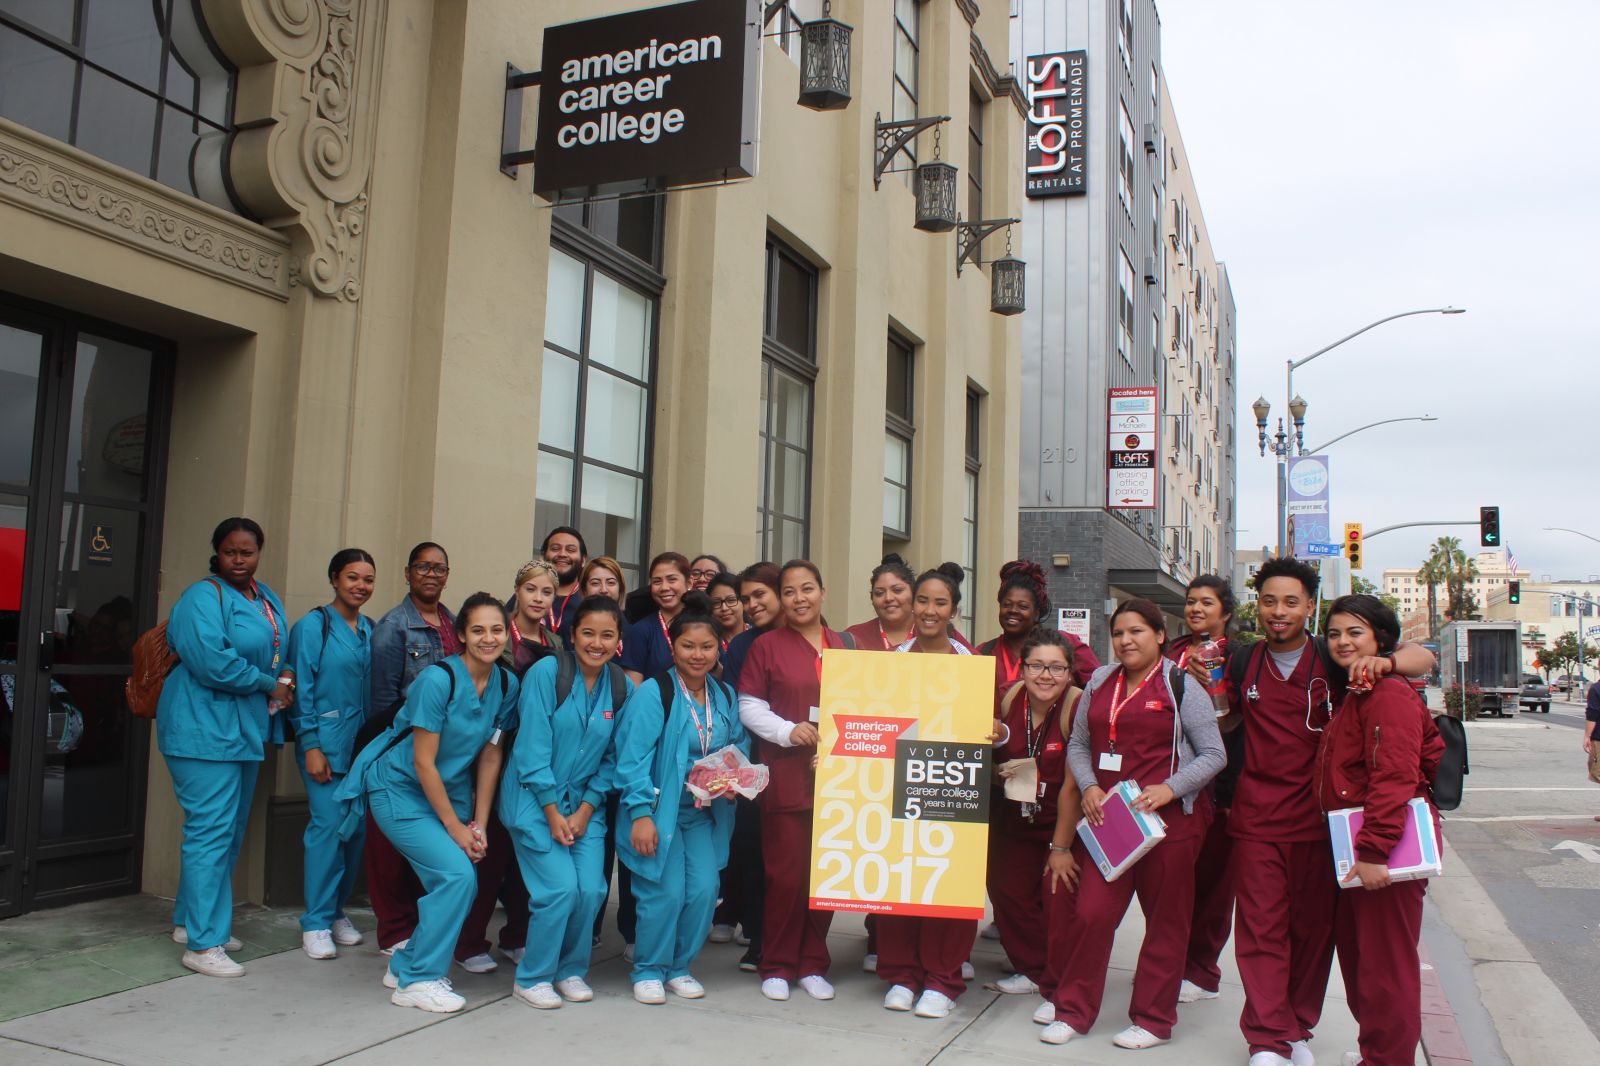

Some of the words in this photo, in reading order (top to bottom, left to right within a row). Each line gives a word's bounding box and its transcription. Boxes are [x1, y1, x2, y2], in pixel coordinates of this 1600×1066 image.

[561, 35, 722, 84] american
[558, 74, 671, 114] career
[1070, 58, 1082, 148] PROMENADE
[1027, 56, 1067, 174] LOFTS
[557, 108, 685, 149] college
[1028, 134, 1037, 151] THE
[1070, 155, 1082, 172] AT
[1028, 176, 1082, 190] RENTALS
[1041, 447, 1078, 464] 210
[1116, 470, 1148, 479] leasing
[1119, 479, 1145, 487] office
[1115, 487, 1149, 496] parking
[1309, 544, 1329, 553] Waite
[826, 656, 960, 704] 2013
[844, 721, 899, 733] american
[844, 731, 883, 741] career
[844, 741, 887, 753] college
[909, 746, 983, 760] voted
[822, 757, 894, 801] 20
[906, 759, 983, 786] BEST
[906, 786, 939, 797] career
[941, 787, 979, 801] college
[904, 797, 921, 820] 5
[923, 800, 946, 809] years
[947, 800, 954, 808] in
[817, 801, 955, 857] 2016
[815, 850, 950, 905] 2017
[816, 901, 892, 911] americancareercollege.edu
